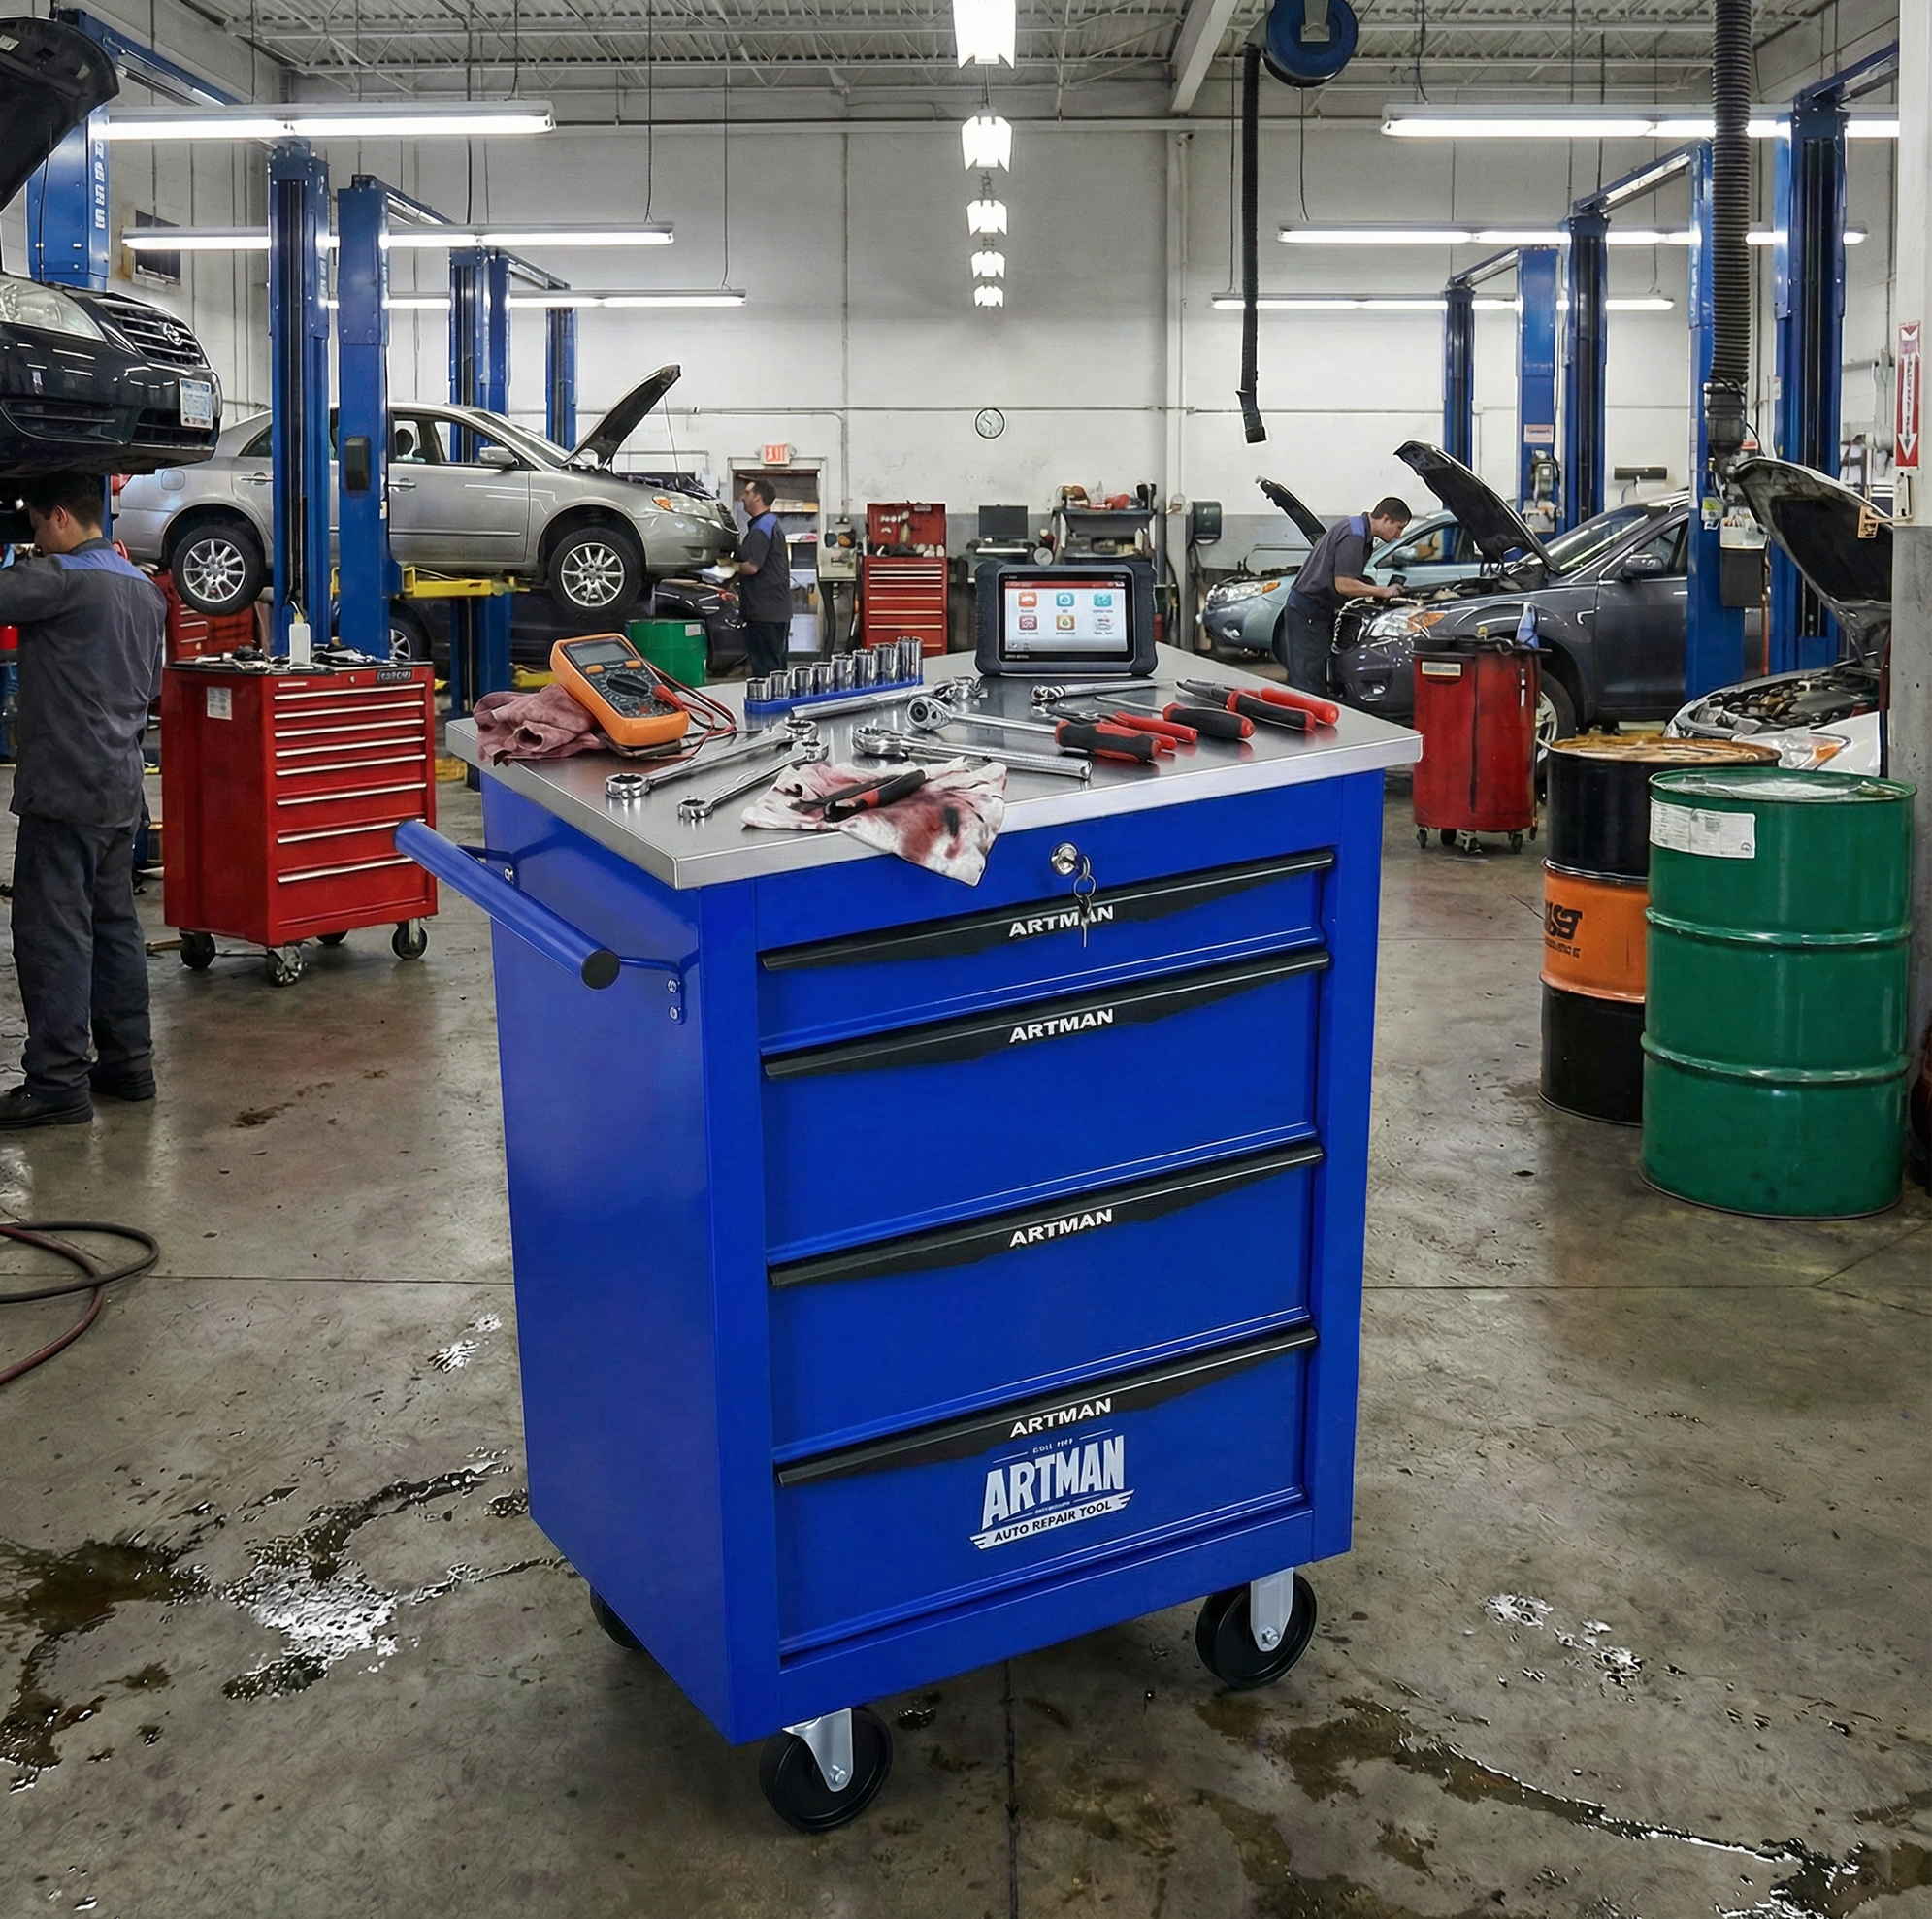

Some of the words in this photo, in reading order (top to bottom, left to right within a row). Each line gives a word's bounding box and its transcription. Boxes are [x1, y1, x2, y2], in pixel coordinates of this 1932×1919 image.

[1009, 1008, 1113, 1043] ARTMAN
[1009, 1209, 1112, 1248] ARTMAN
[1009, 1398, 1111, 1438] ARTMAN
[981, 1435, 1125, 1531] ARTMAN
[994, 1524, 1029, 1543] AUTO
[1032, 1511, 1076, 1531] REPAIR
[1079, 1500, 1112, 1517] TOOL
